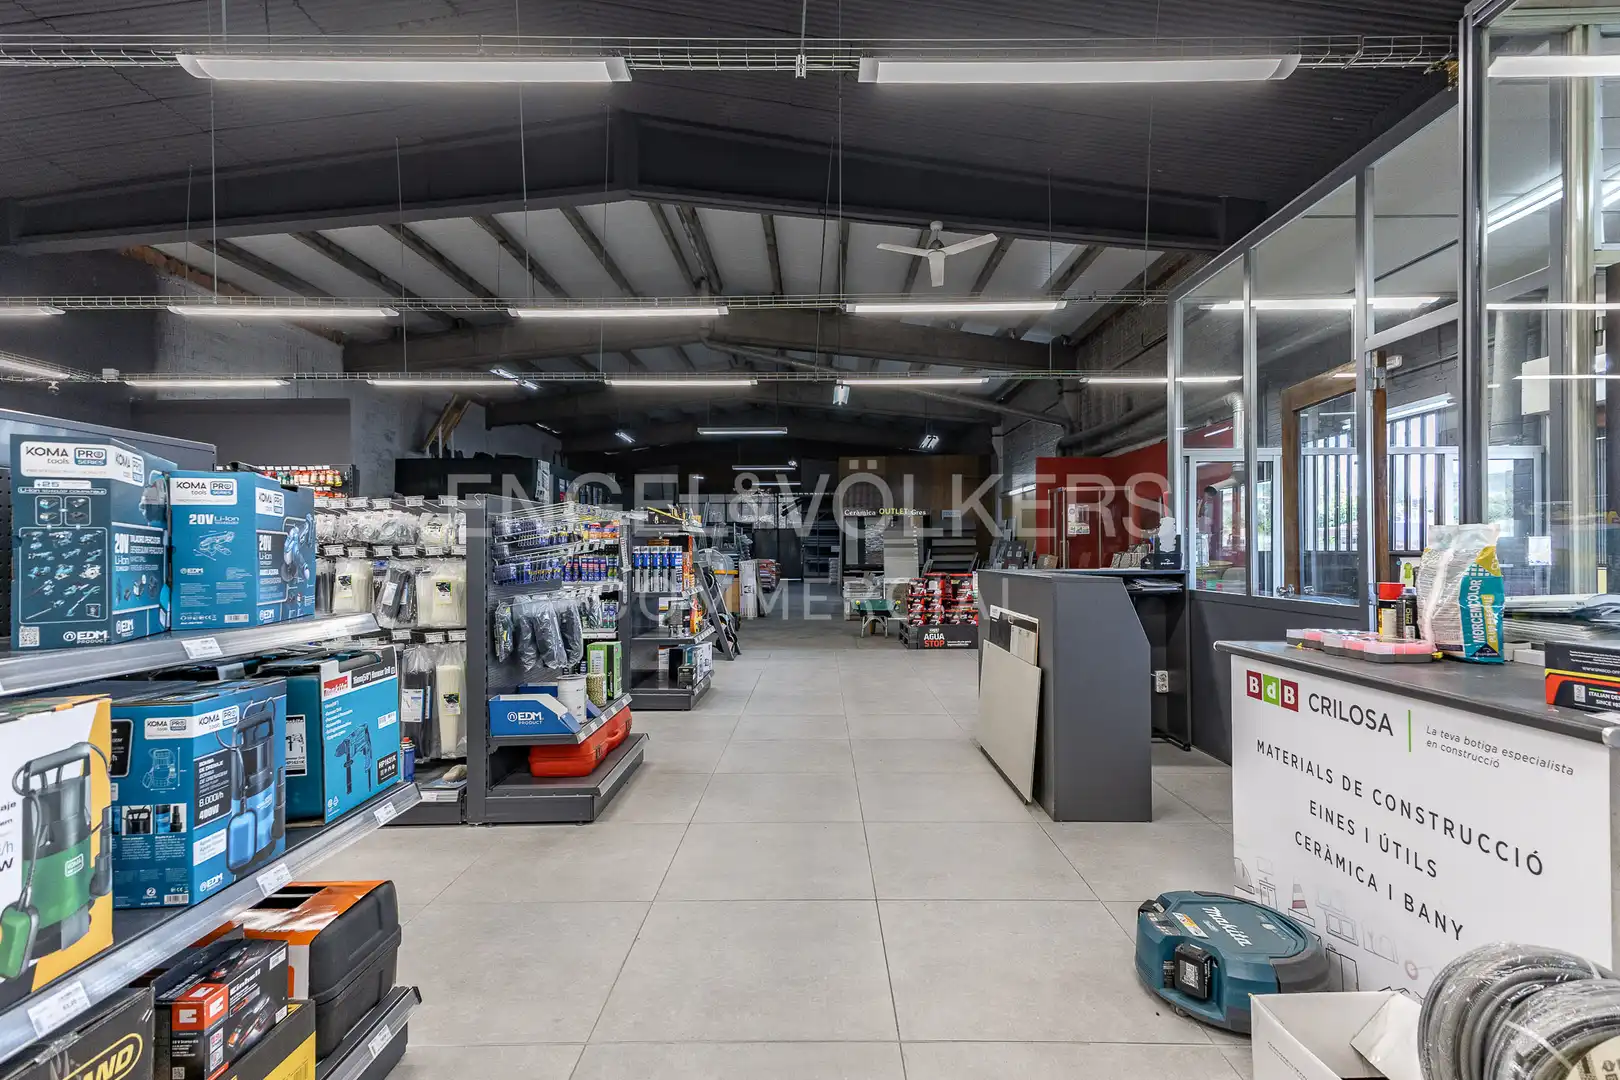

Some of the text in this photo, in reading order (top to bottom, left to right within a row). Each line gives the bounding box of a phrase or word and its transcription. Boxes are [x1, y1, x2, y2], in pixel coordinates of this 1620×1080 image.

[26, 447, 69, 457] KOMA
[77, 450, 104, 458] PRO
[176, 481, 207, 490] KOMA
[212, 482, 232, 490] PRO
[879, 507, 908, 516] OUTLET
[189, 513, 214, 525] 20V
[77, 630, 108, 640] EDM
[924, 633, 945, 641] AGUA
[924, 640, 945, 648] STOP
[1588, 691, 1610, 700] ITALIAN
[1249, 673, 1394, 737] BdB CRILOSA
[1596, 699, 1612, 707] SINCE
[199, 714, 220, 726] KOMA
[518, 711, 542, 721] EDM
[1426, 726, 1575, 776] La teva botiga especialista
[1426, 741, 1500, 769] en construcció
[199, 803, 220, 820] 400W
[1257, 739, 1544, 877] MATERIALS DE CONSTRUCCIÓ
[1310, 800, 1437, 879] EINES I ÚTILS
[1295, 831, 1464, 942] CERÀMICA I BANY
